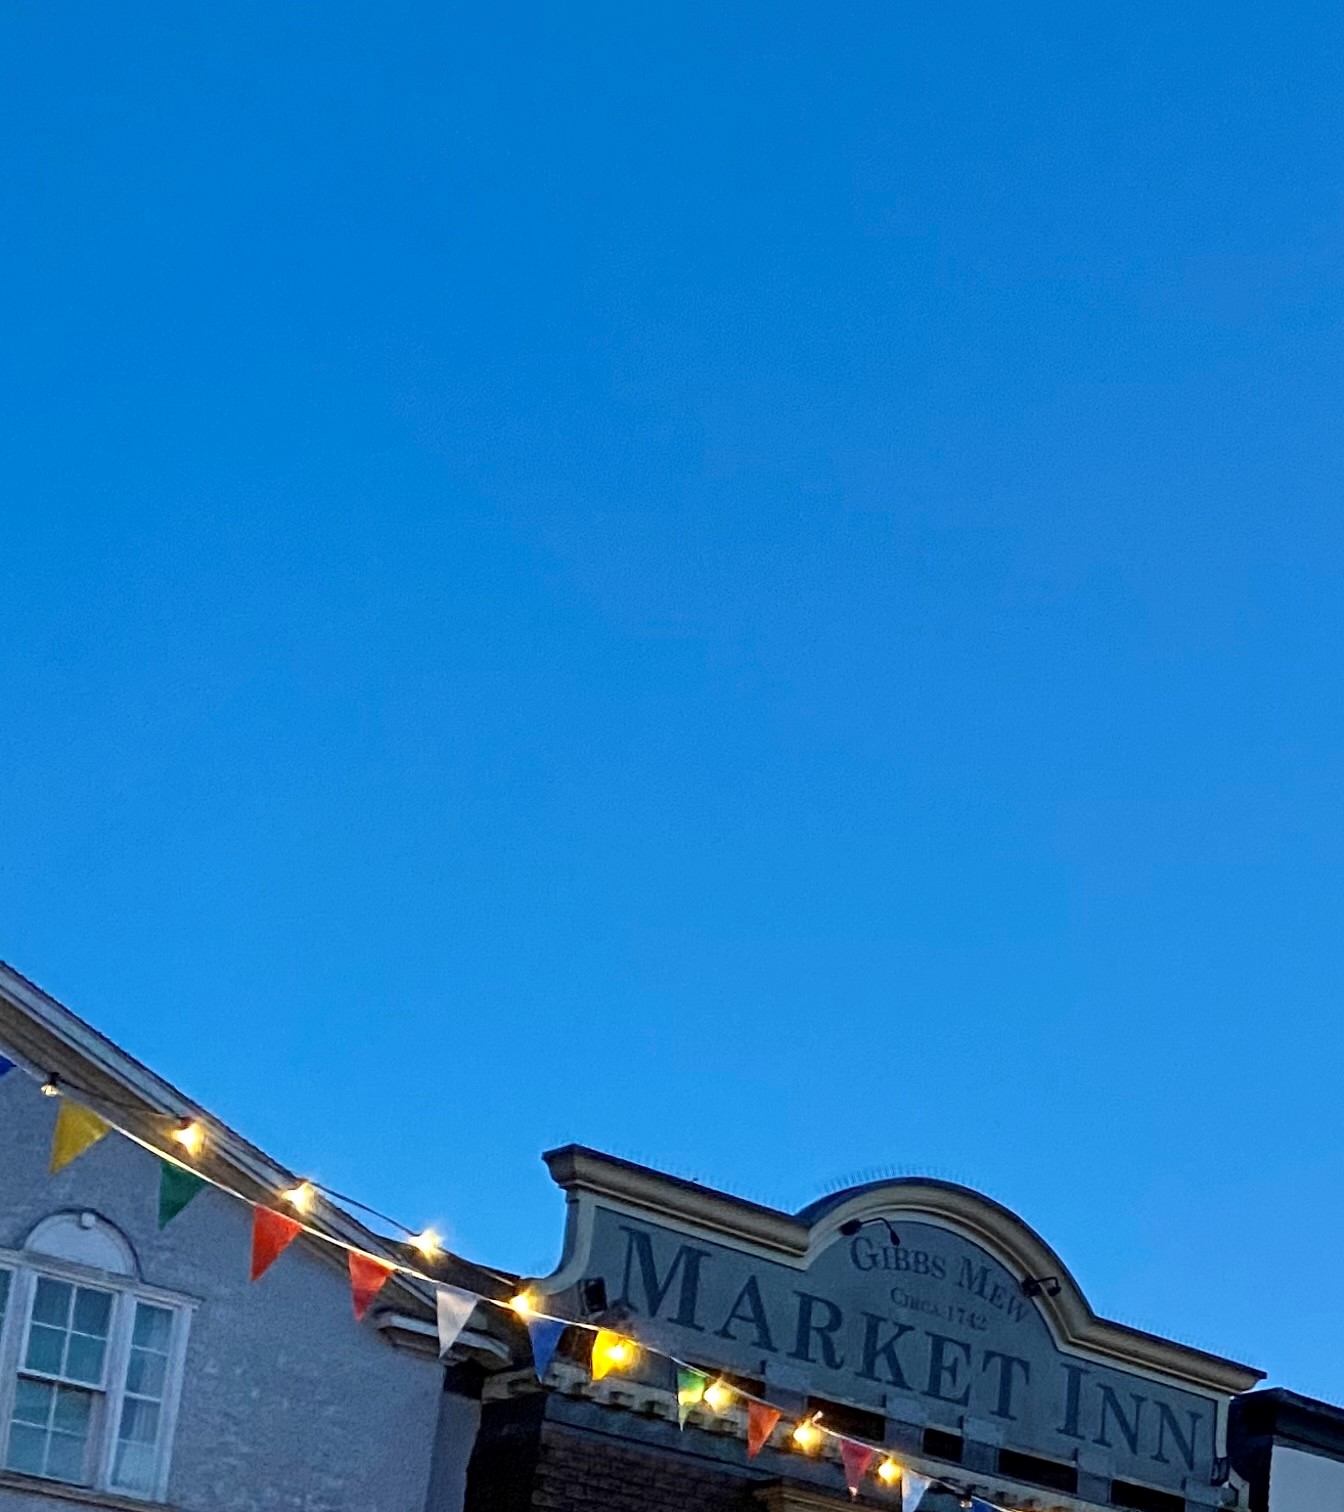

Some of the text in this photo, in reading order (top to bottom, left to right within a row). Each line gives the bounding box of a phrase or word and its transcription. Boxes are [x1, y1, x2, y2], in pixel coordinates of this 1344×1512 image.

[618, 1225, 1201, 1471] MARKET INN
[851, 1236, 1028, 1323] GIBBS MEW
